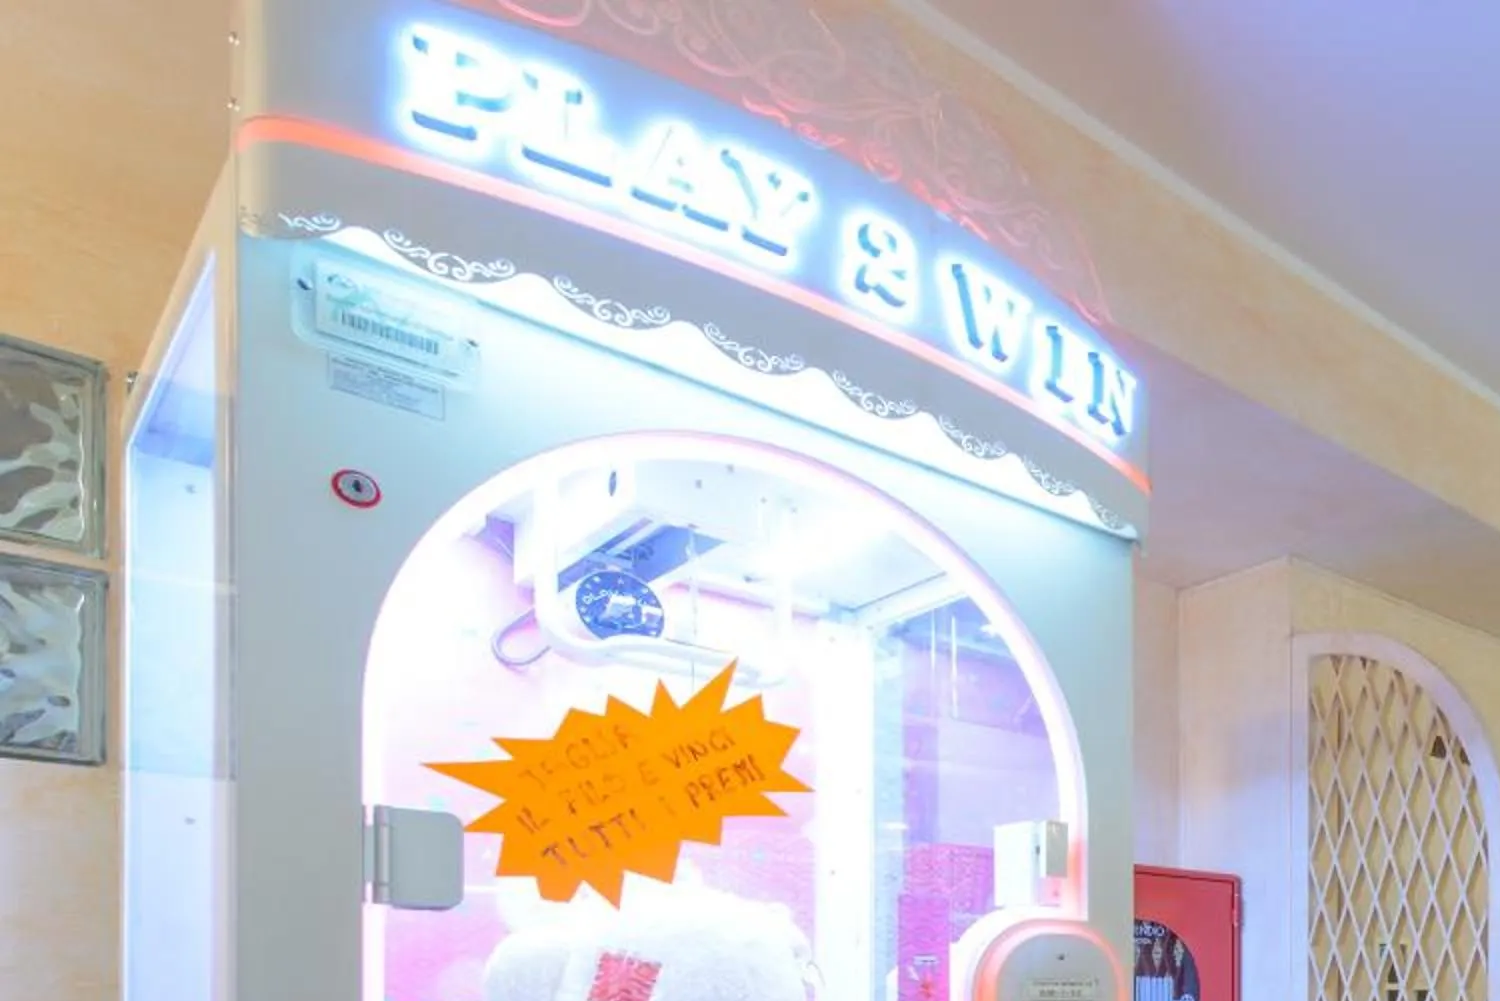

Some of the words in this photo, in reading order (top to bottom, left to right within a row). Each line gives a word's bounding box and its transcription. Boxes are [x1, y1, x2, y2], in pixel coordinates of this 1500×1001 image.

[402, 24, 814, 262] PLAY
[940, 253, 1138, 450] WIN
[638, 760, 660, 786] E
[662, 726, 736, 768] VINCI
[685, 754, 765, 808] PREMI
